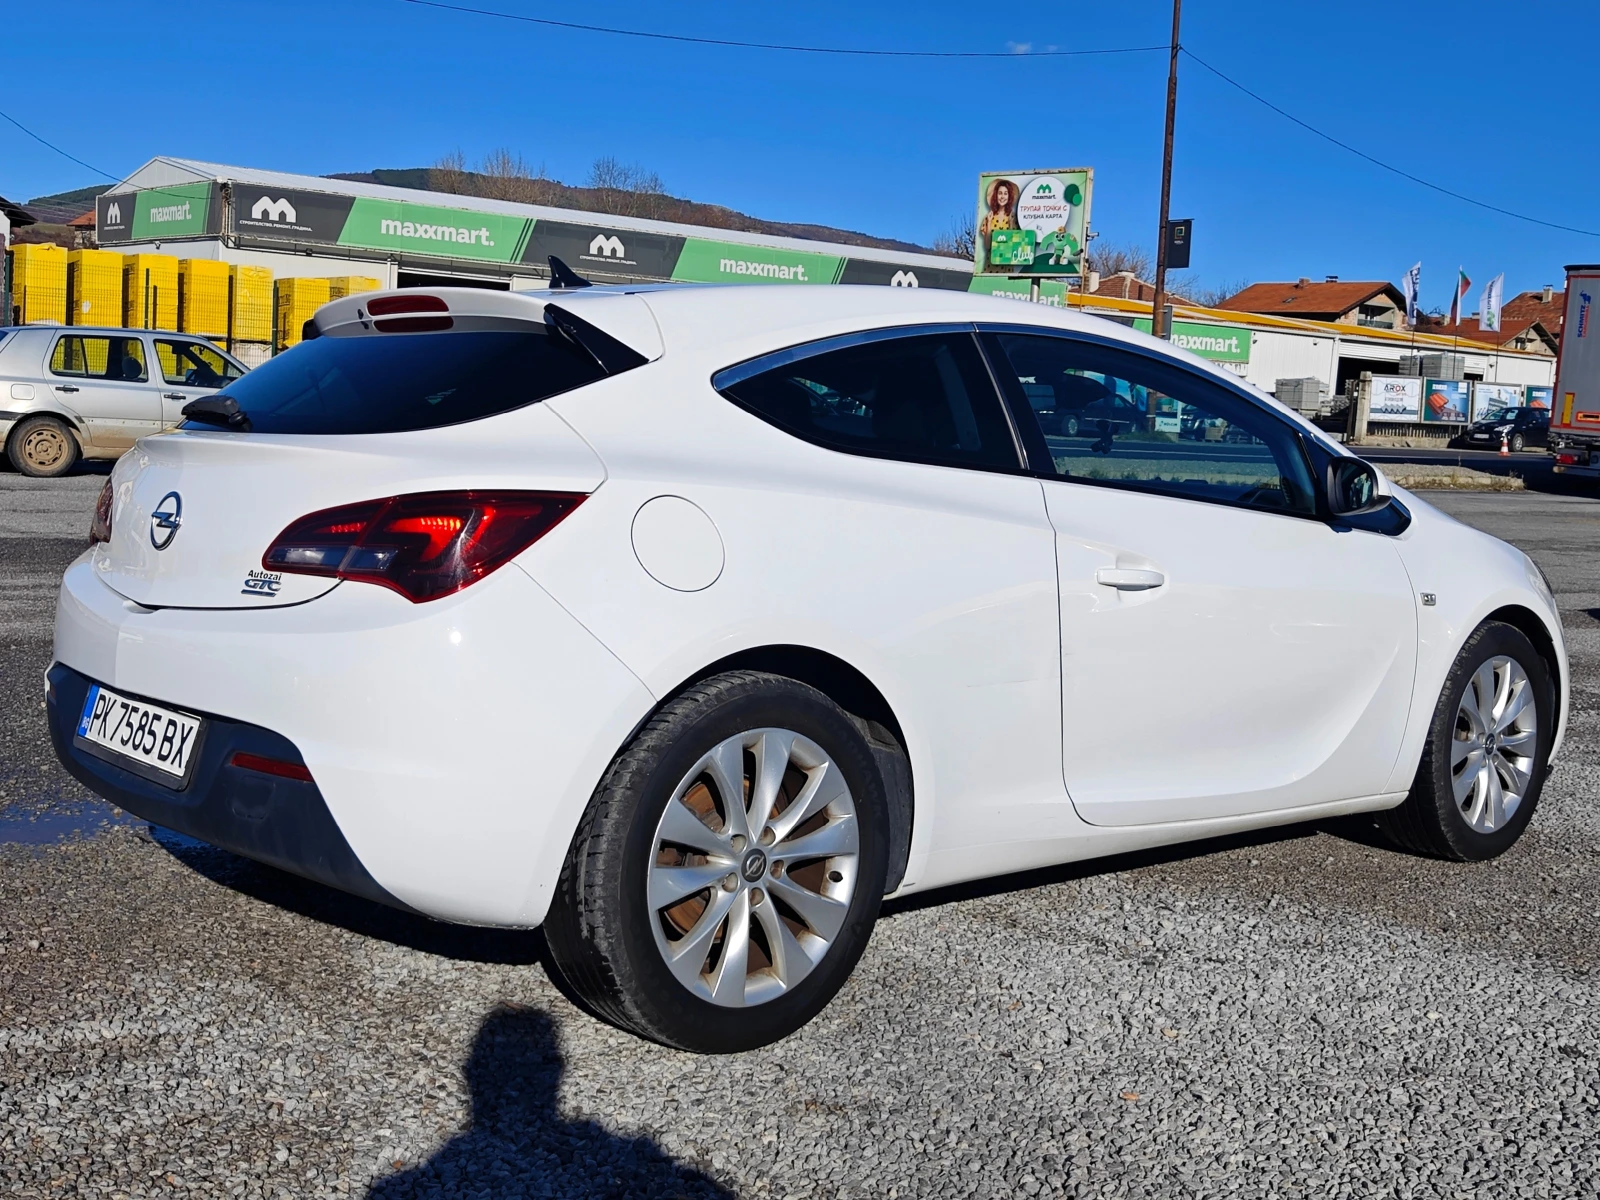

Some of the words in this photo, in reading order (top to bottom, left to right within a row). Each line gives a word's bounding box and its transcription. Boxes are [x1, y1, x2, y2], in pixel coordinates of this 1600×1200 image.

[150, 200, 192, 223] maxxmart.
[1043, 204, 1061, 212] ТОЧКИ
[380, 219, 495, 247] maxxmart.
[720, 259, 808, 281] maxxmart.
[1384, 384, 1406, 393] AROX
[248, 569, 283, 581] Autozai
[244, 578, 282, 592] GTC
[89, 693, 118, 739] PK
[109, 701, 163, 756] 7585
[157, 718, 194, 769] BX
